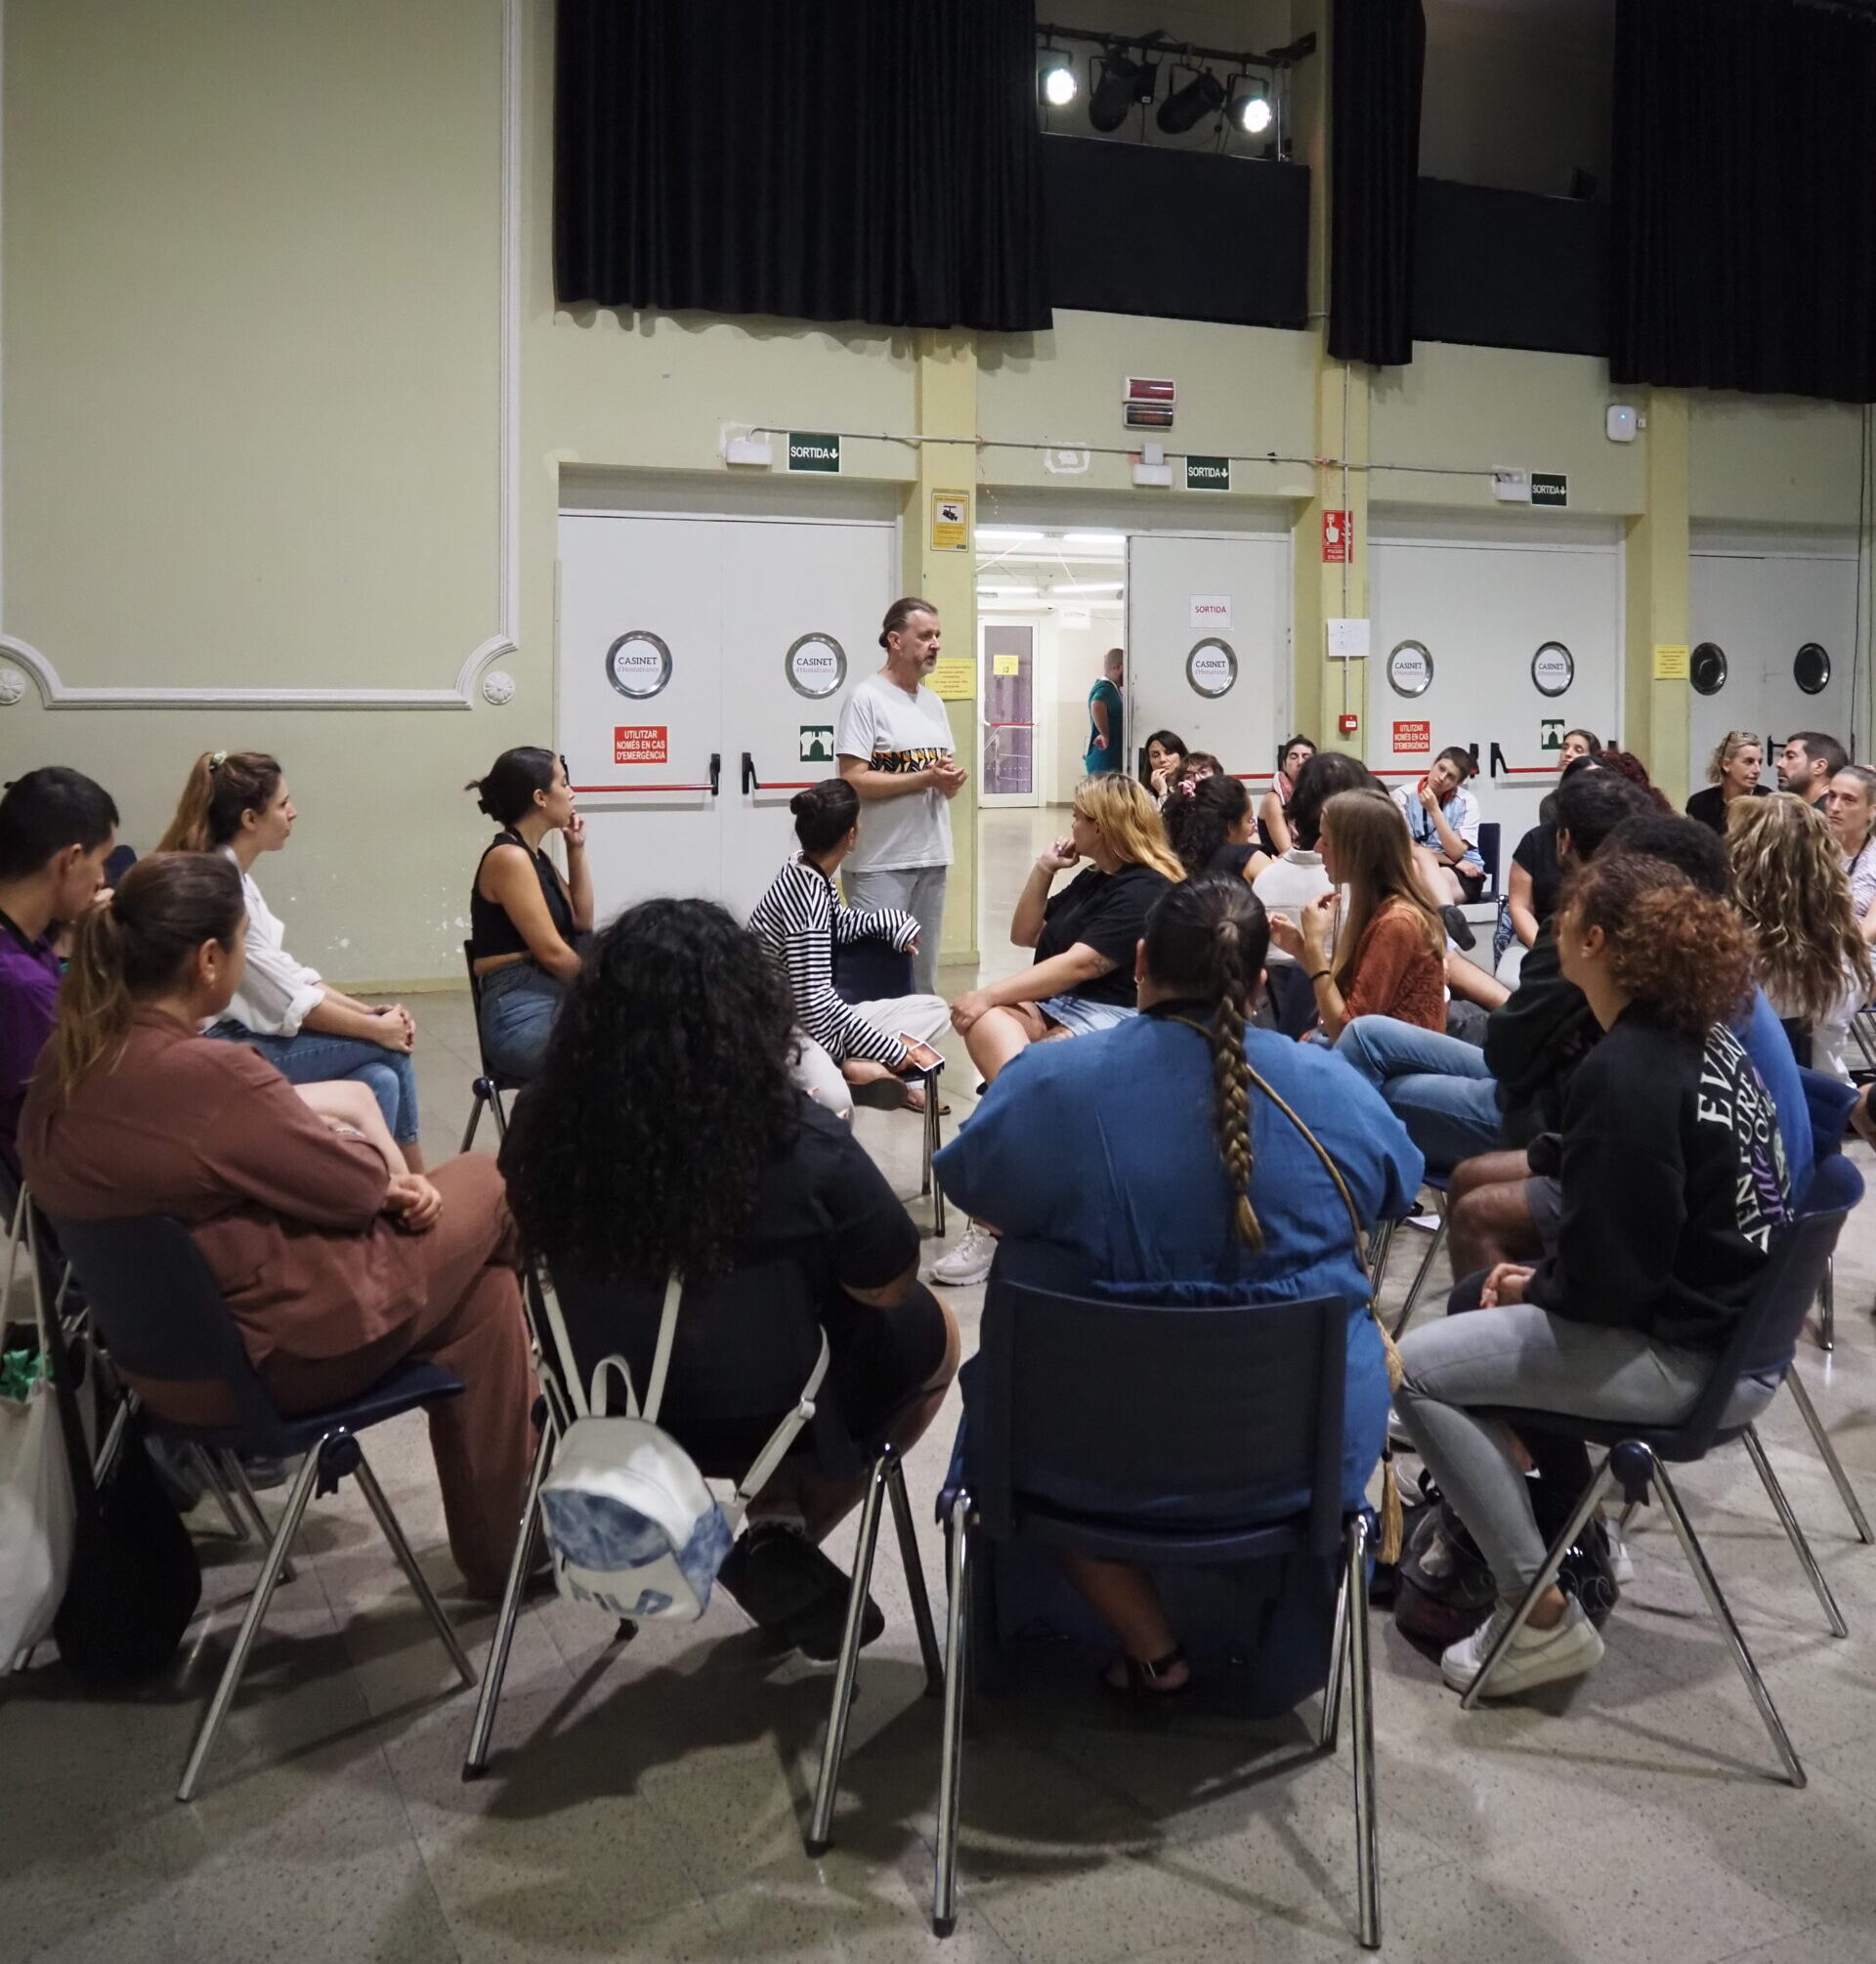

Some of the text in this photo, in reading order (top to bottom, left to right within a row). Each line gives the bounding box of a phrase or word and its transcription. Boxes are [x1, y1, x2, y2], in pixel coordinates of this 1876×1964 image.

[789, 446, 830, 459] SORTIDA
[1187, 466, 1221, 478] SORTIDA
[1532, 484, 1560, 494] SORTIDA
[1195, 605, 1227, 614] SORTIDA
[618, 657, 658, 665] CASINET
[796, 658, 833, 666] CASINET
[1399, 724, 1424, 733] UTILITZAR
[624, 730, 658, 740] UTILITZAR
[617, 739, 665, 749] NOMÉS EN CAS
